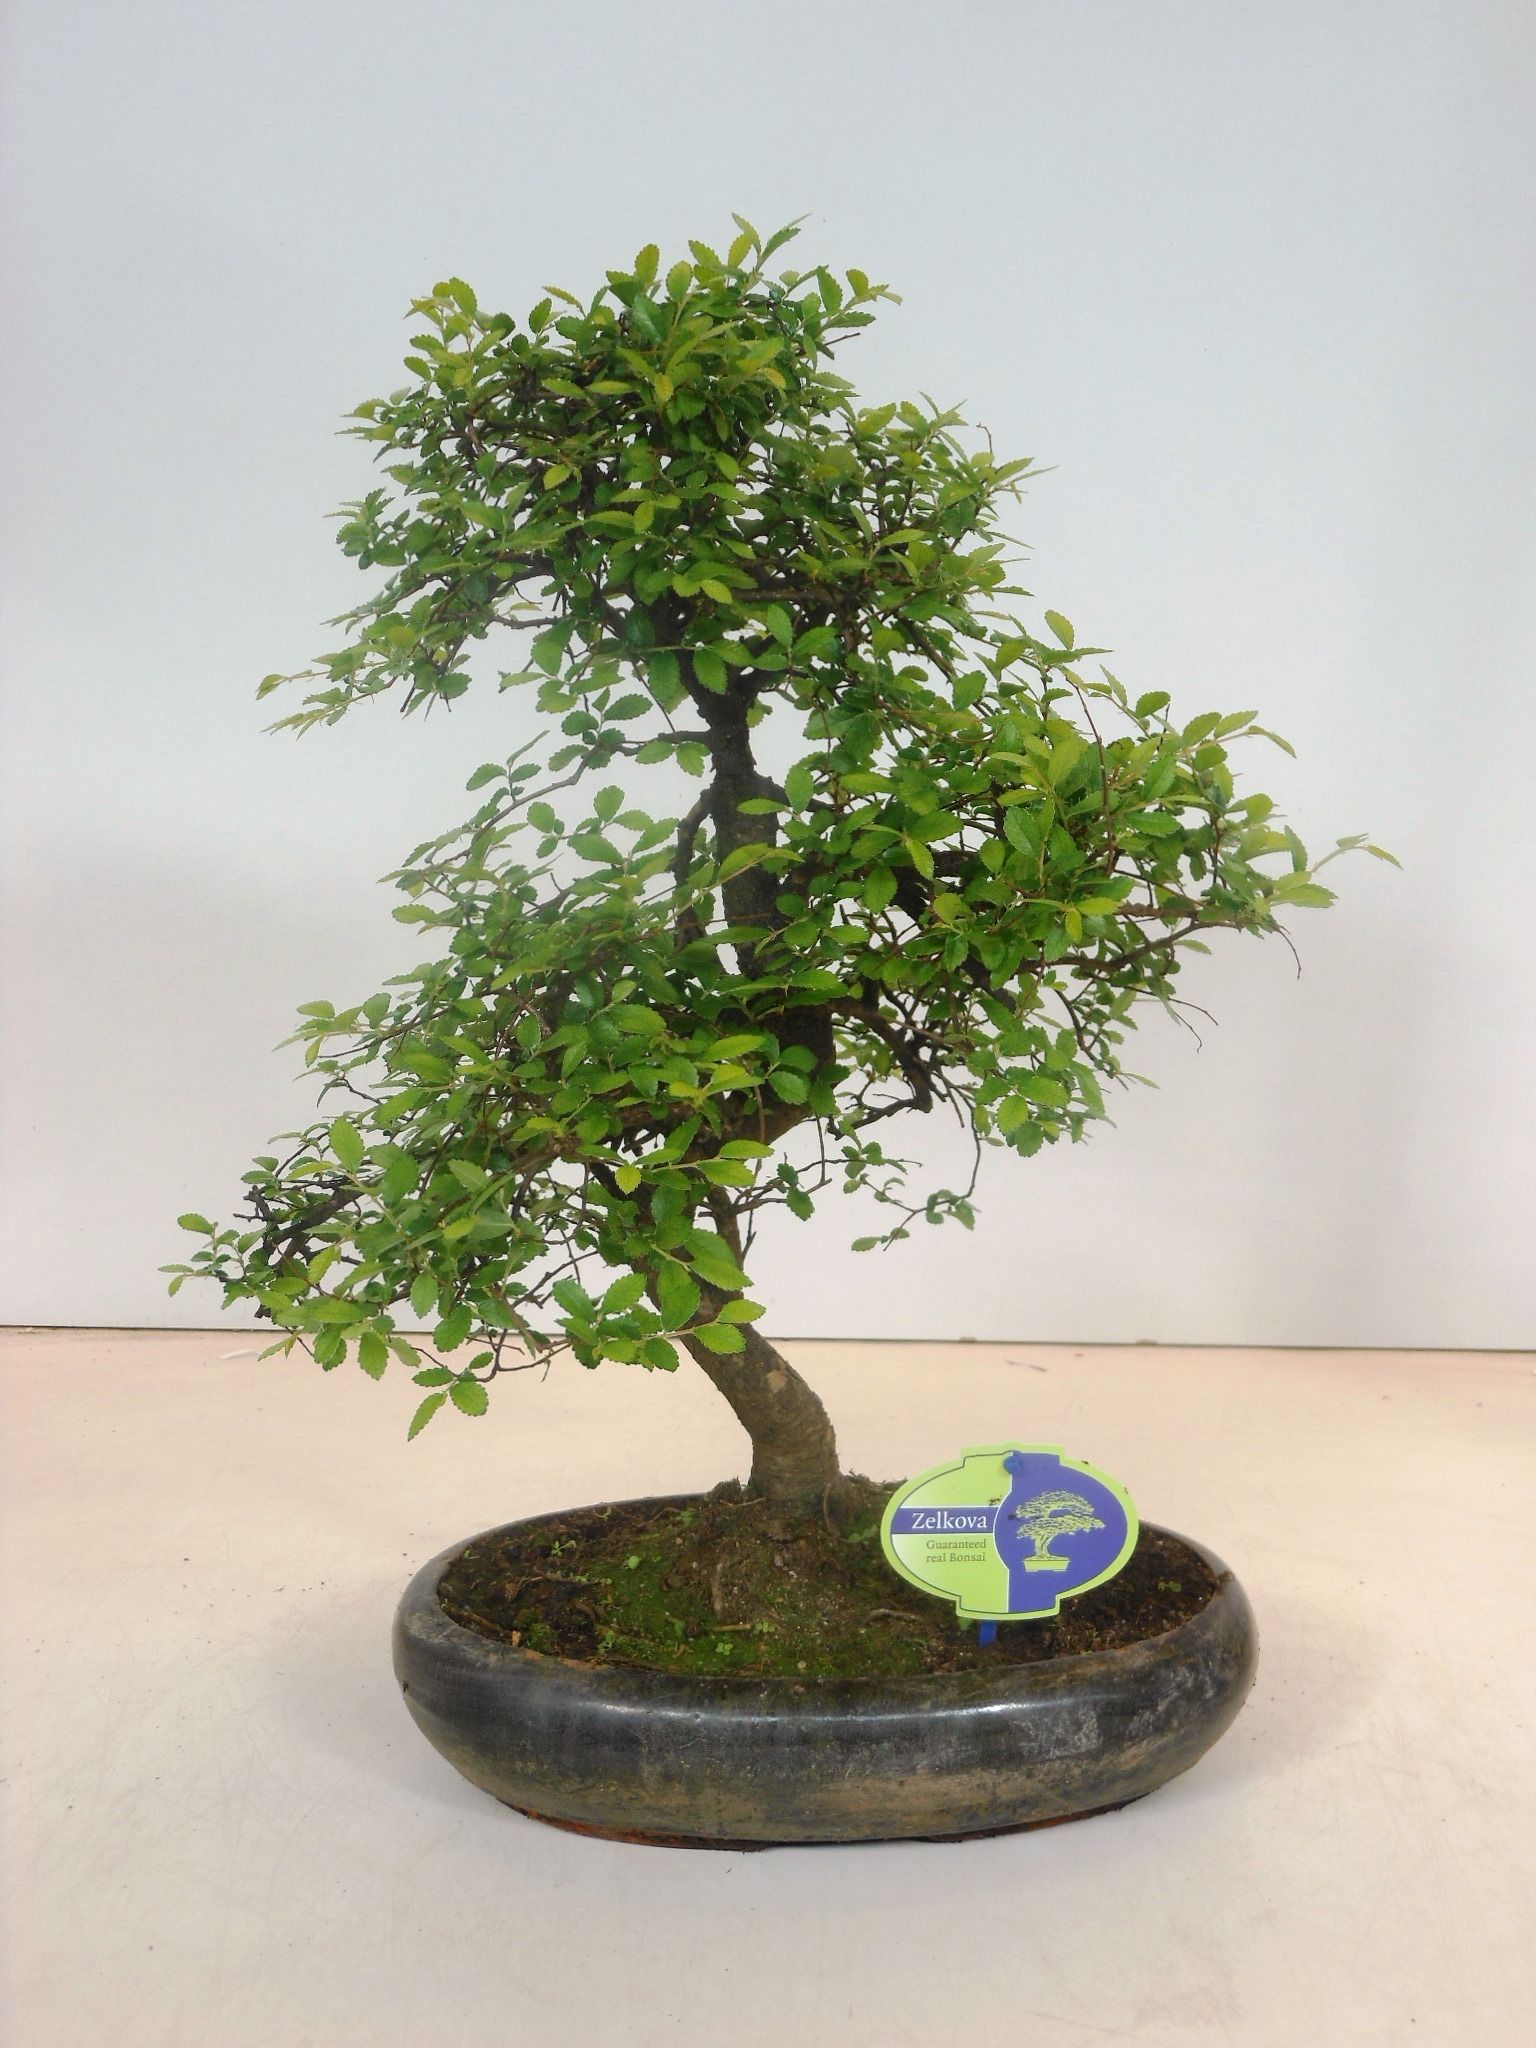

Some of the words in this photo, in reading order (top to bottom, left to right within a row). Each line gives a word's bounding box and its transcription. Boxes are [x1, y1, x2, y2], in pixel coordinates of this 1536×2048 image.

[911, 1510, 988, 1529] Zelkova
[926, 1538, 987, 1549] Guaranteed
[926, 1552, 947, 1563] real
[949, 1551, 986, 1562] Bonsai
